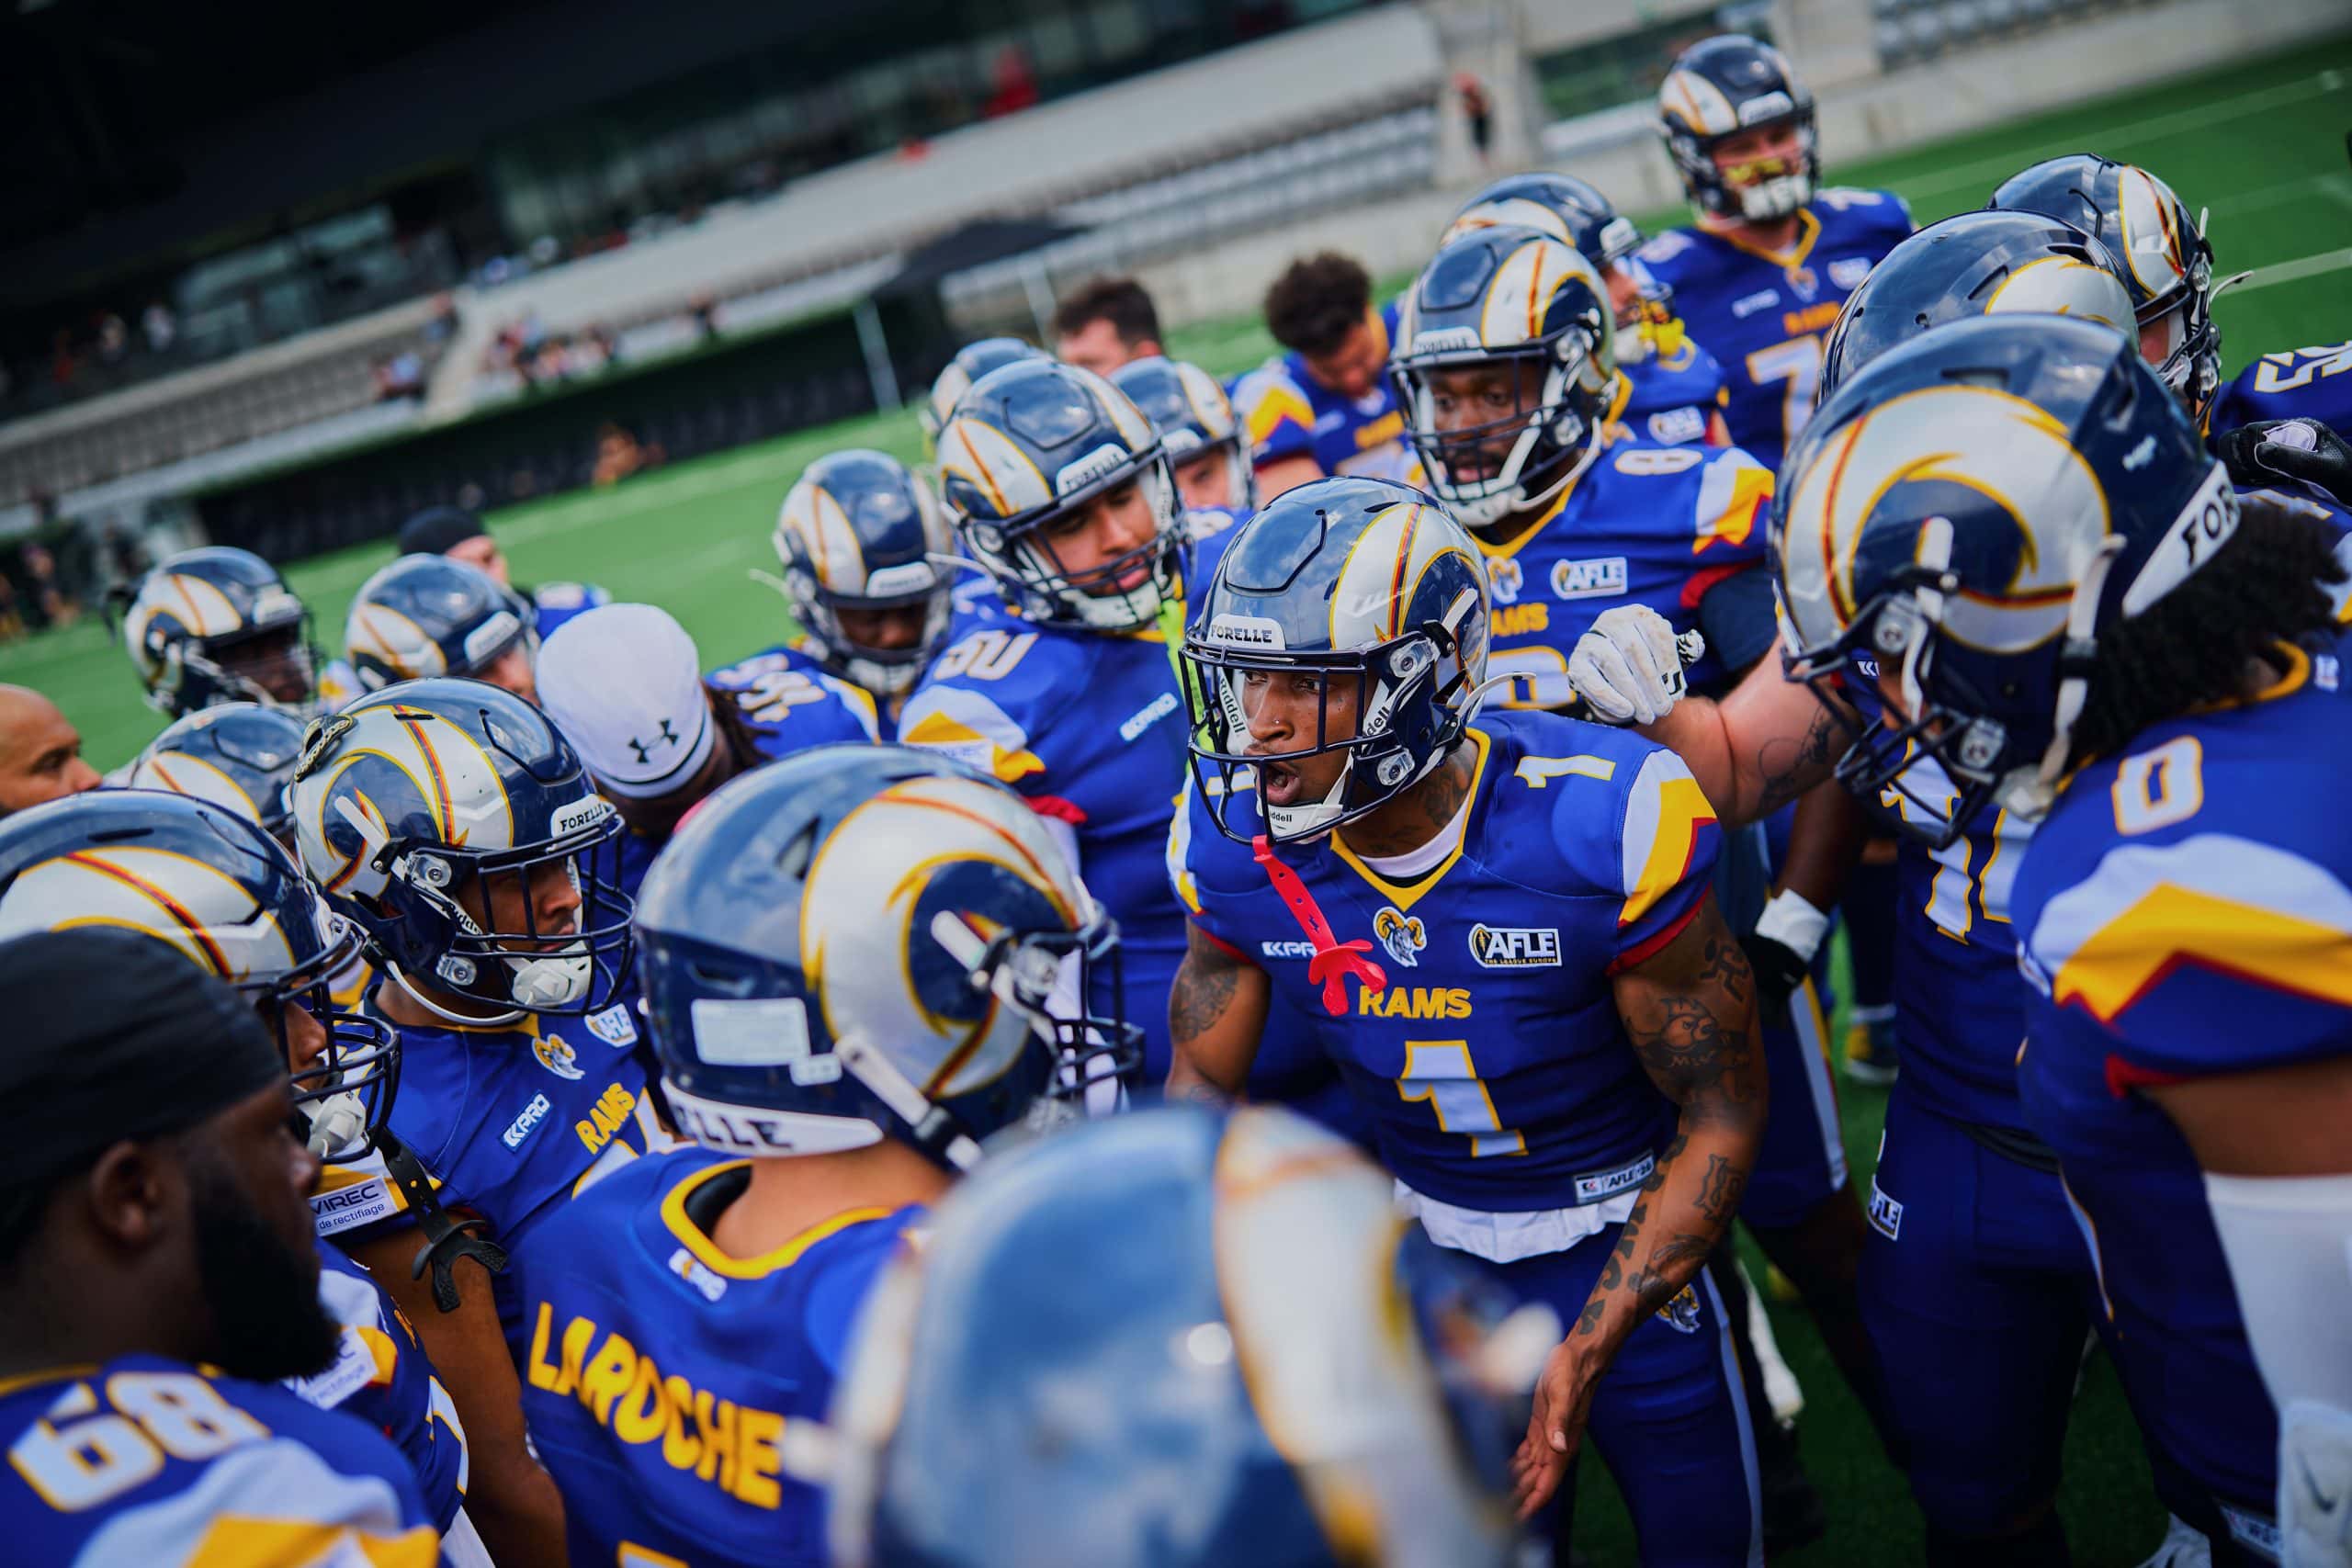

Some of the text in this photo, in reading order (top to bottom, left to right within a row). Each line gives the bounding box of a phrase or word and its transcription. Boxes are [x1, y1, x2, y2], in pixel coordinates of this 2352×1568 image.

[1211, 625, 1272, 643] FORELLE
[1490, 603, 1549, 637] AMS
[1365, 705, 1390, 737] dell
[1513, 753, 1617, 789] 1
[1271, 812, 1293, 823] ddell
[1261, 940, 1317, 957] KPR
[1485, 931, 1556, 959] AFLE
[1358, 984, 1473, 1020] RAMS
[1394, 1039, 1530, 1159] 1
[574, 1082, 636, 1155] RAMS
[527, 1300, 786, 1511] LAROCHE
[6, 1371, 274, 1514] 68
